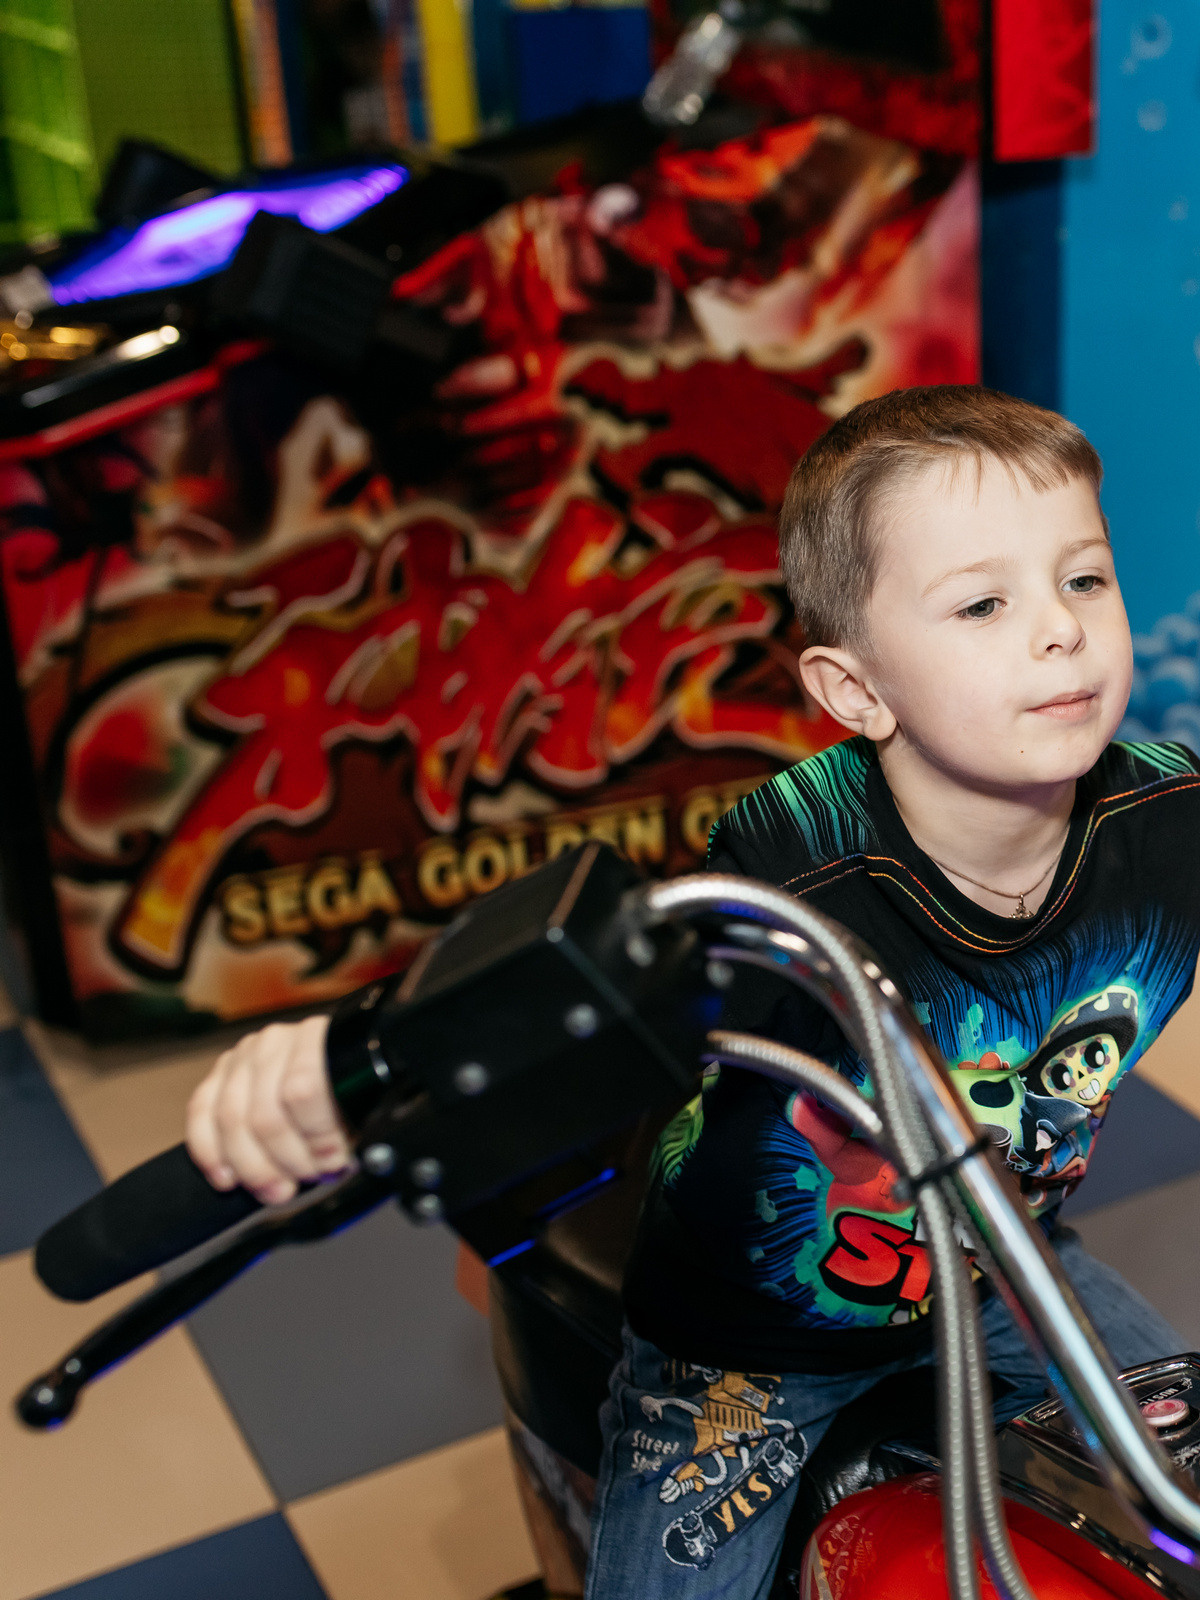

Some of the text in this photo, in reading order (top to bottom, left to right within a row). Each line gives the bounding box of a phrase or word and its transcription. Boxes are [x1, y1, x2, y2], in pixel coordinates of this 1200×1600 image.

[221, 855, 400, 942] SEGA
[631, 1429, 680, 1455] Street
[712, 1472, 773, 1533] YES
